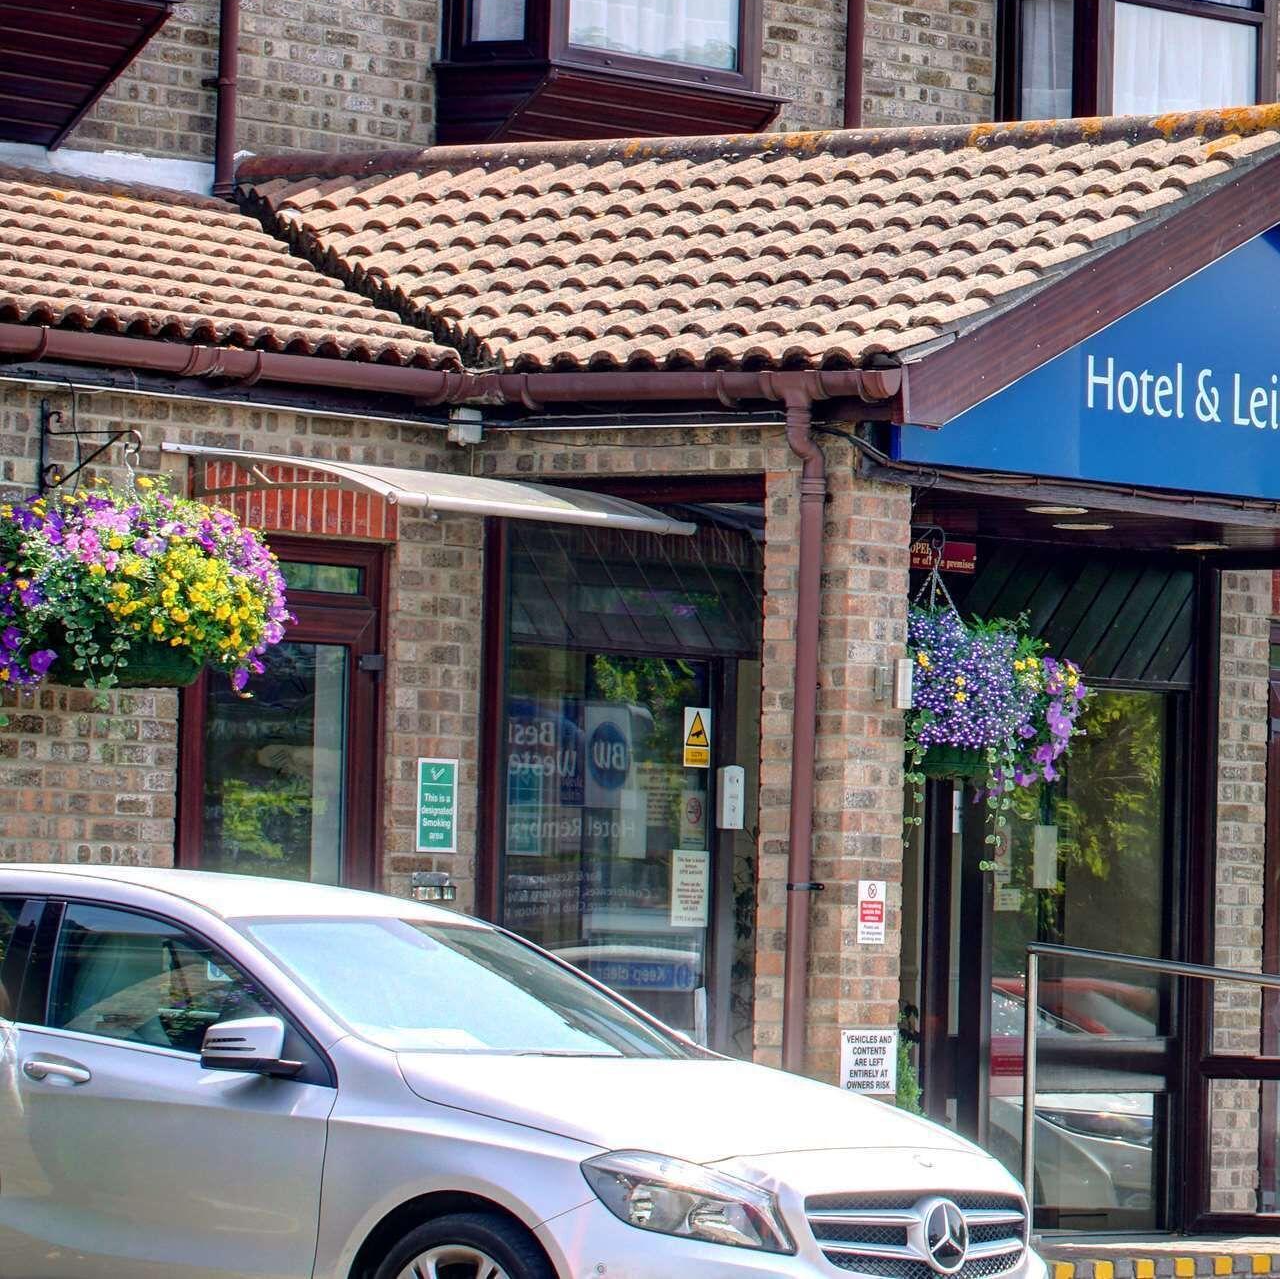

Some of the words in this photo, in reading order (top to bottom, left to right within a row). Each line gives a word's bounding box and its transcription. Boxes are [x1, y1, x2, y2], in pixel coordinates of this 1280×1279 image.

[1086, 353, 1185, 420] Hotel
[1195, 367, 1221, 423] &
[946, 559, 975, 569] premises
[424, 793, 438, 803] This
[439, 794, 446, 803] is
[421, 805, 453, 817] designated
[422, 818, 451, 830] Smoking
[847, 1035, 878, 1044] VEHICLES
[879, 1035, 892, 1044] AND
[852, 1046, 886, 1055] CONTENTS
[854, 1058, 867, 1066] ARE
[868, 1058, 884, 1067] LEFT
[849, 1069, 879, 1078] ENTIRELY
[880, 1069, 889, 1078] AT
[846, 1081, 875, 1089] OWNERS
[875, 1081, 890, 1090] RISK
